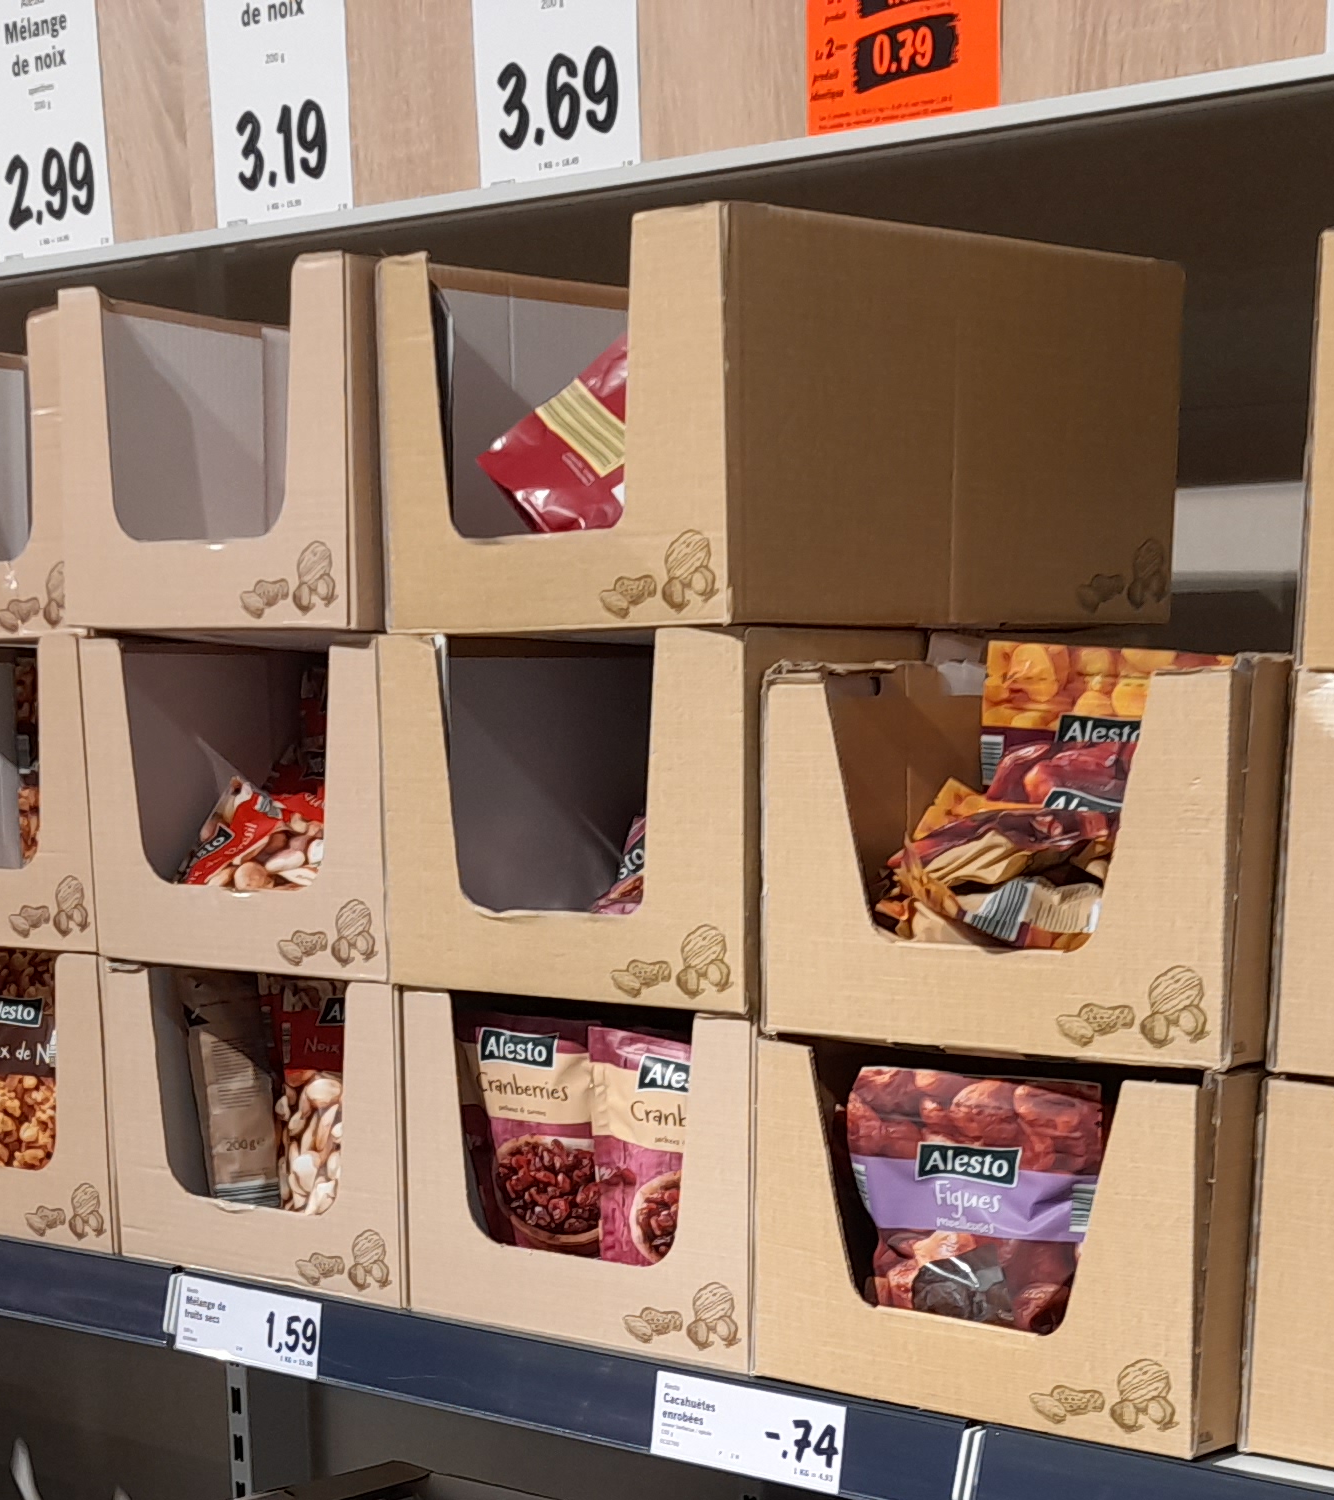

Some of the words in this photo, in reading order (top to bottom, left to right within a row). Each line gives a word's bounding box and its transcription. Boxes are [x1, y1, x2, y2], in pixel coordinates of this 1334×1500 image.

[4, 11, 68, 45] Mélange
[240, 5, 261, 28] de
[267, 0, 305, 22] noix
[11, 54, 29, 77] de
[34, 47, 66, 72] noix
[873, 26, 933, 76] 0.79
[497, 44, 619, 150] 3.69
[236, 98, 327, 191] 3.19
[4, 140, 95, 231] 2.99
[16, 1041, 31, 1060] de
[304, 1035, 340, 1054] Noix
[485, 1036, 547, 1062] Alesto
[476, 1071, 569, 1102] Cranberries
[925, 1150, 1008, 1178] Alesto
[934, 1180, 1002, 1218] Figues
[266, 1310, 317, 1355] 1,59
[662, 1409, 704, 1426] enrobées
[663, 1392, 716, 1413] Cacahuètes
